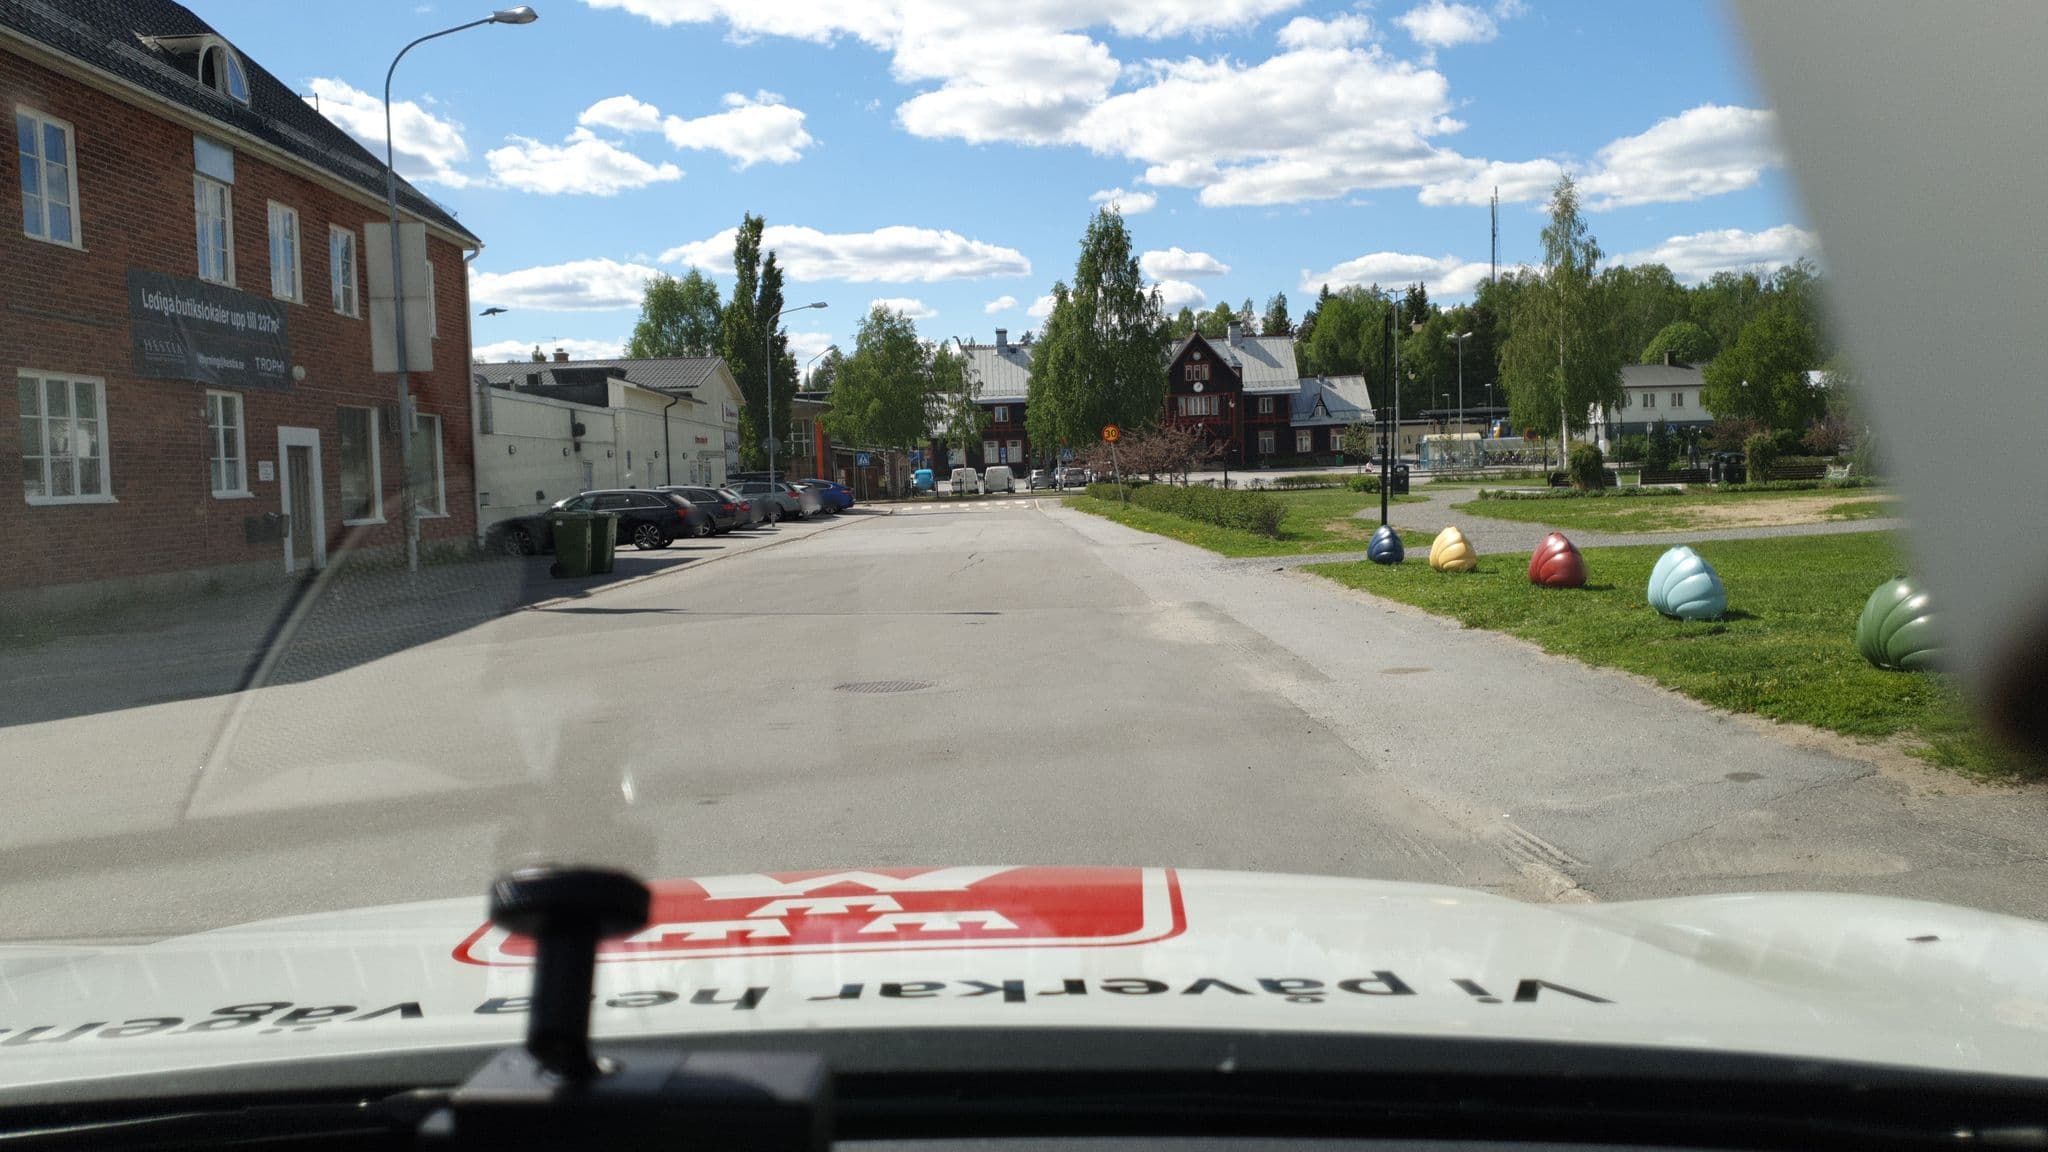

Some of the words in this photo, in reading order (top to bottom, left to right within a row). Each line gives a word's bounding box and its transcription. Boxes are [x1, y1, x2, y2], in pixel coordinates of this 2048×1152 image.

[142, 288, 176, 316] Lediga
[175, 294, 230, 325] butikslokaler
[231, 312, 246, 332] upp
[246, 311, 257, 330] till
[255, 356, 285, 374] TROPHI
[1104, 429, 1117, 438] 30
[474, 986, 769, 1014] hea
[808, 970, 1418, 1003] påverkar
[1450, 978, 1618, 1004] Vi
